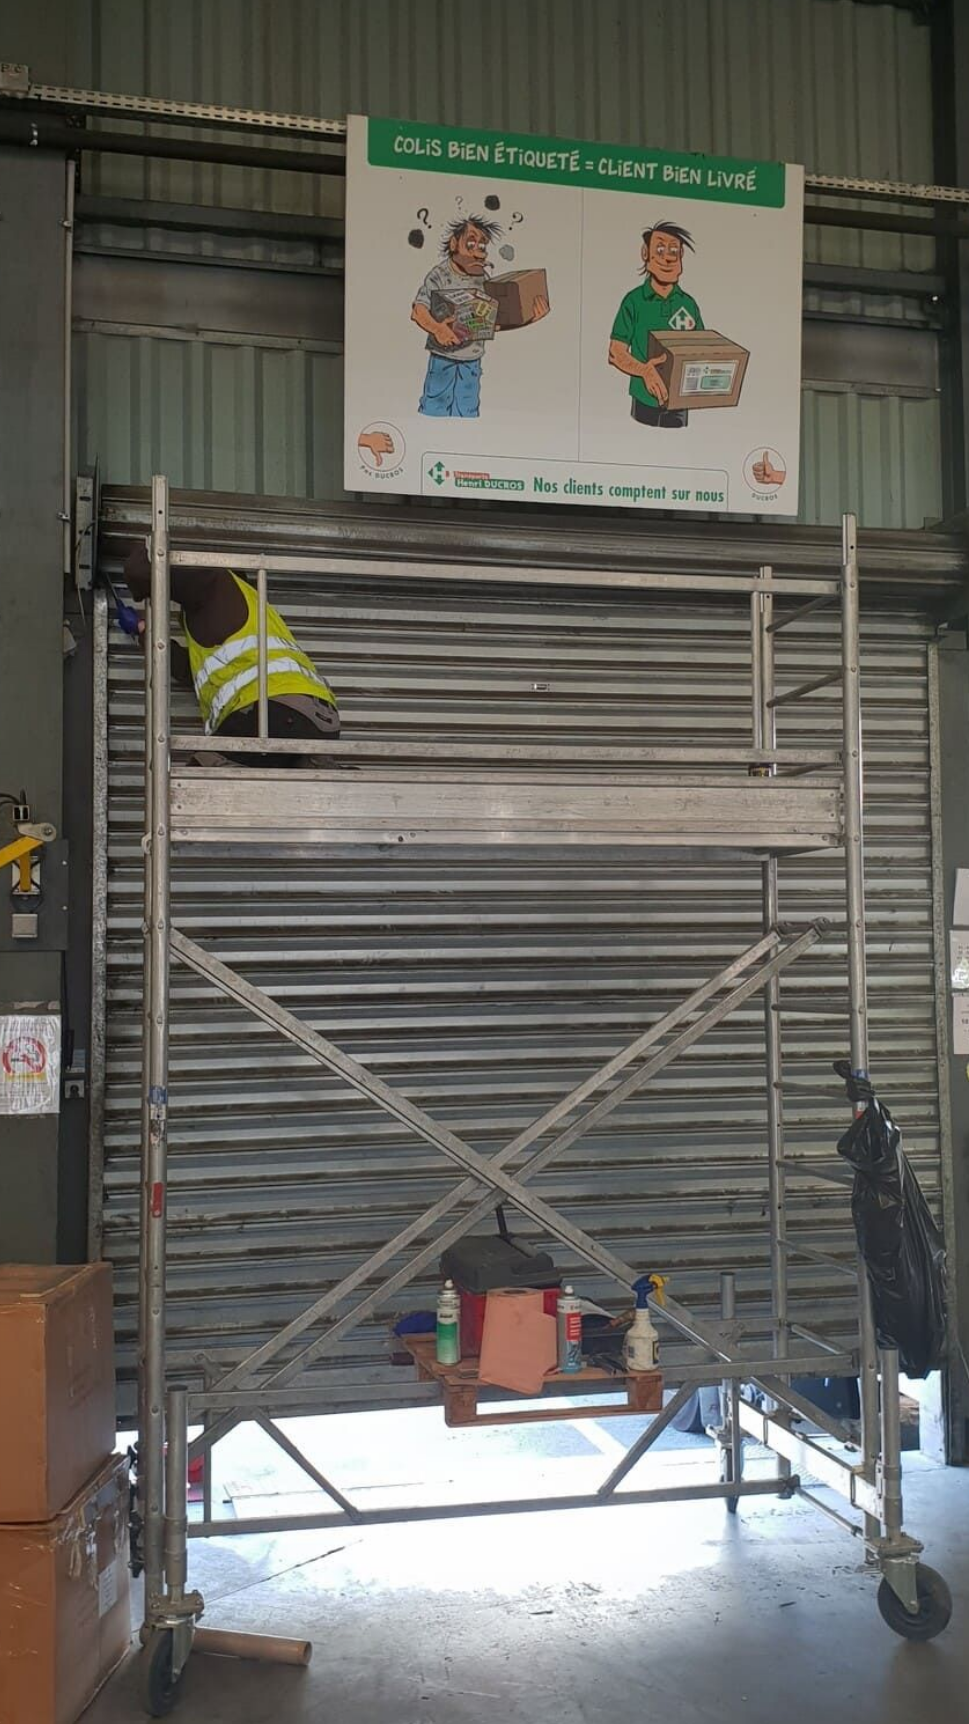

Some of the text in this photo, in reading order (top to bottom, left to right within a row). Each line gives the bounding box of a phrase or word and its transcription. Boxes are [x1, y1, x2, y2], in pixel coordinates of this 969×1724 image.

[457, 479, 523, 490] Henri DUCROS
[533, 476, 725, 502] Nos clients comptent sur nous
